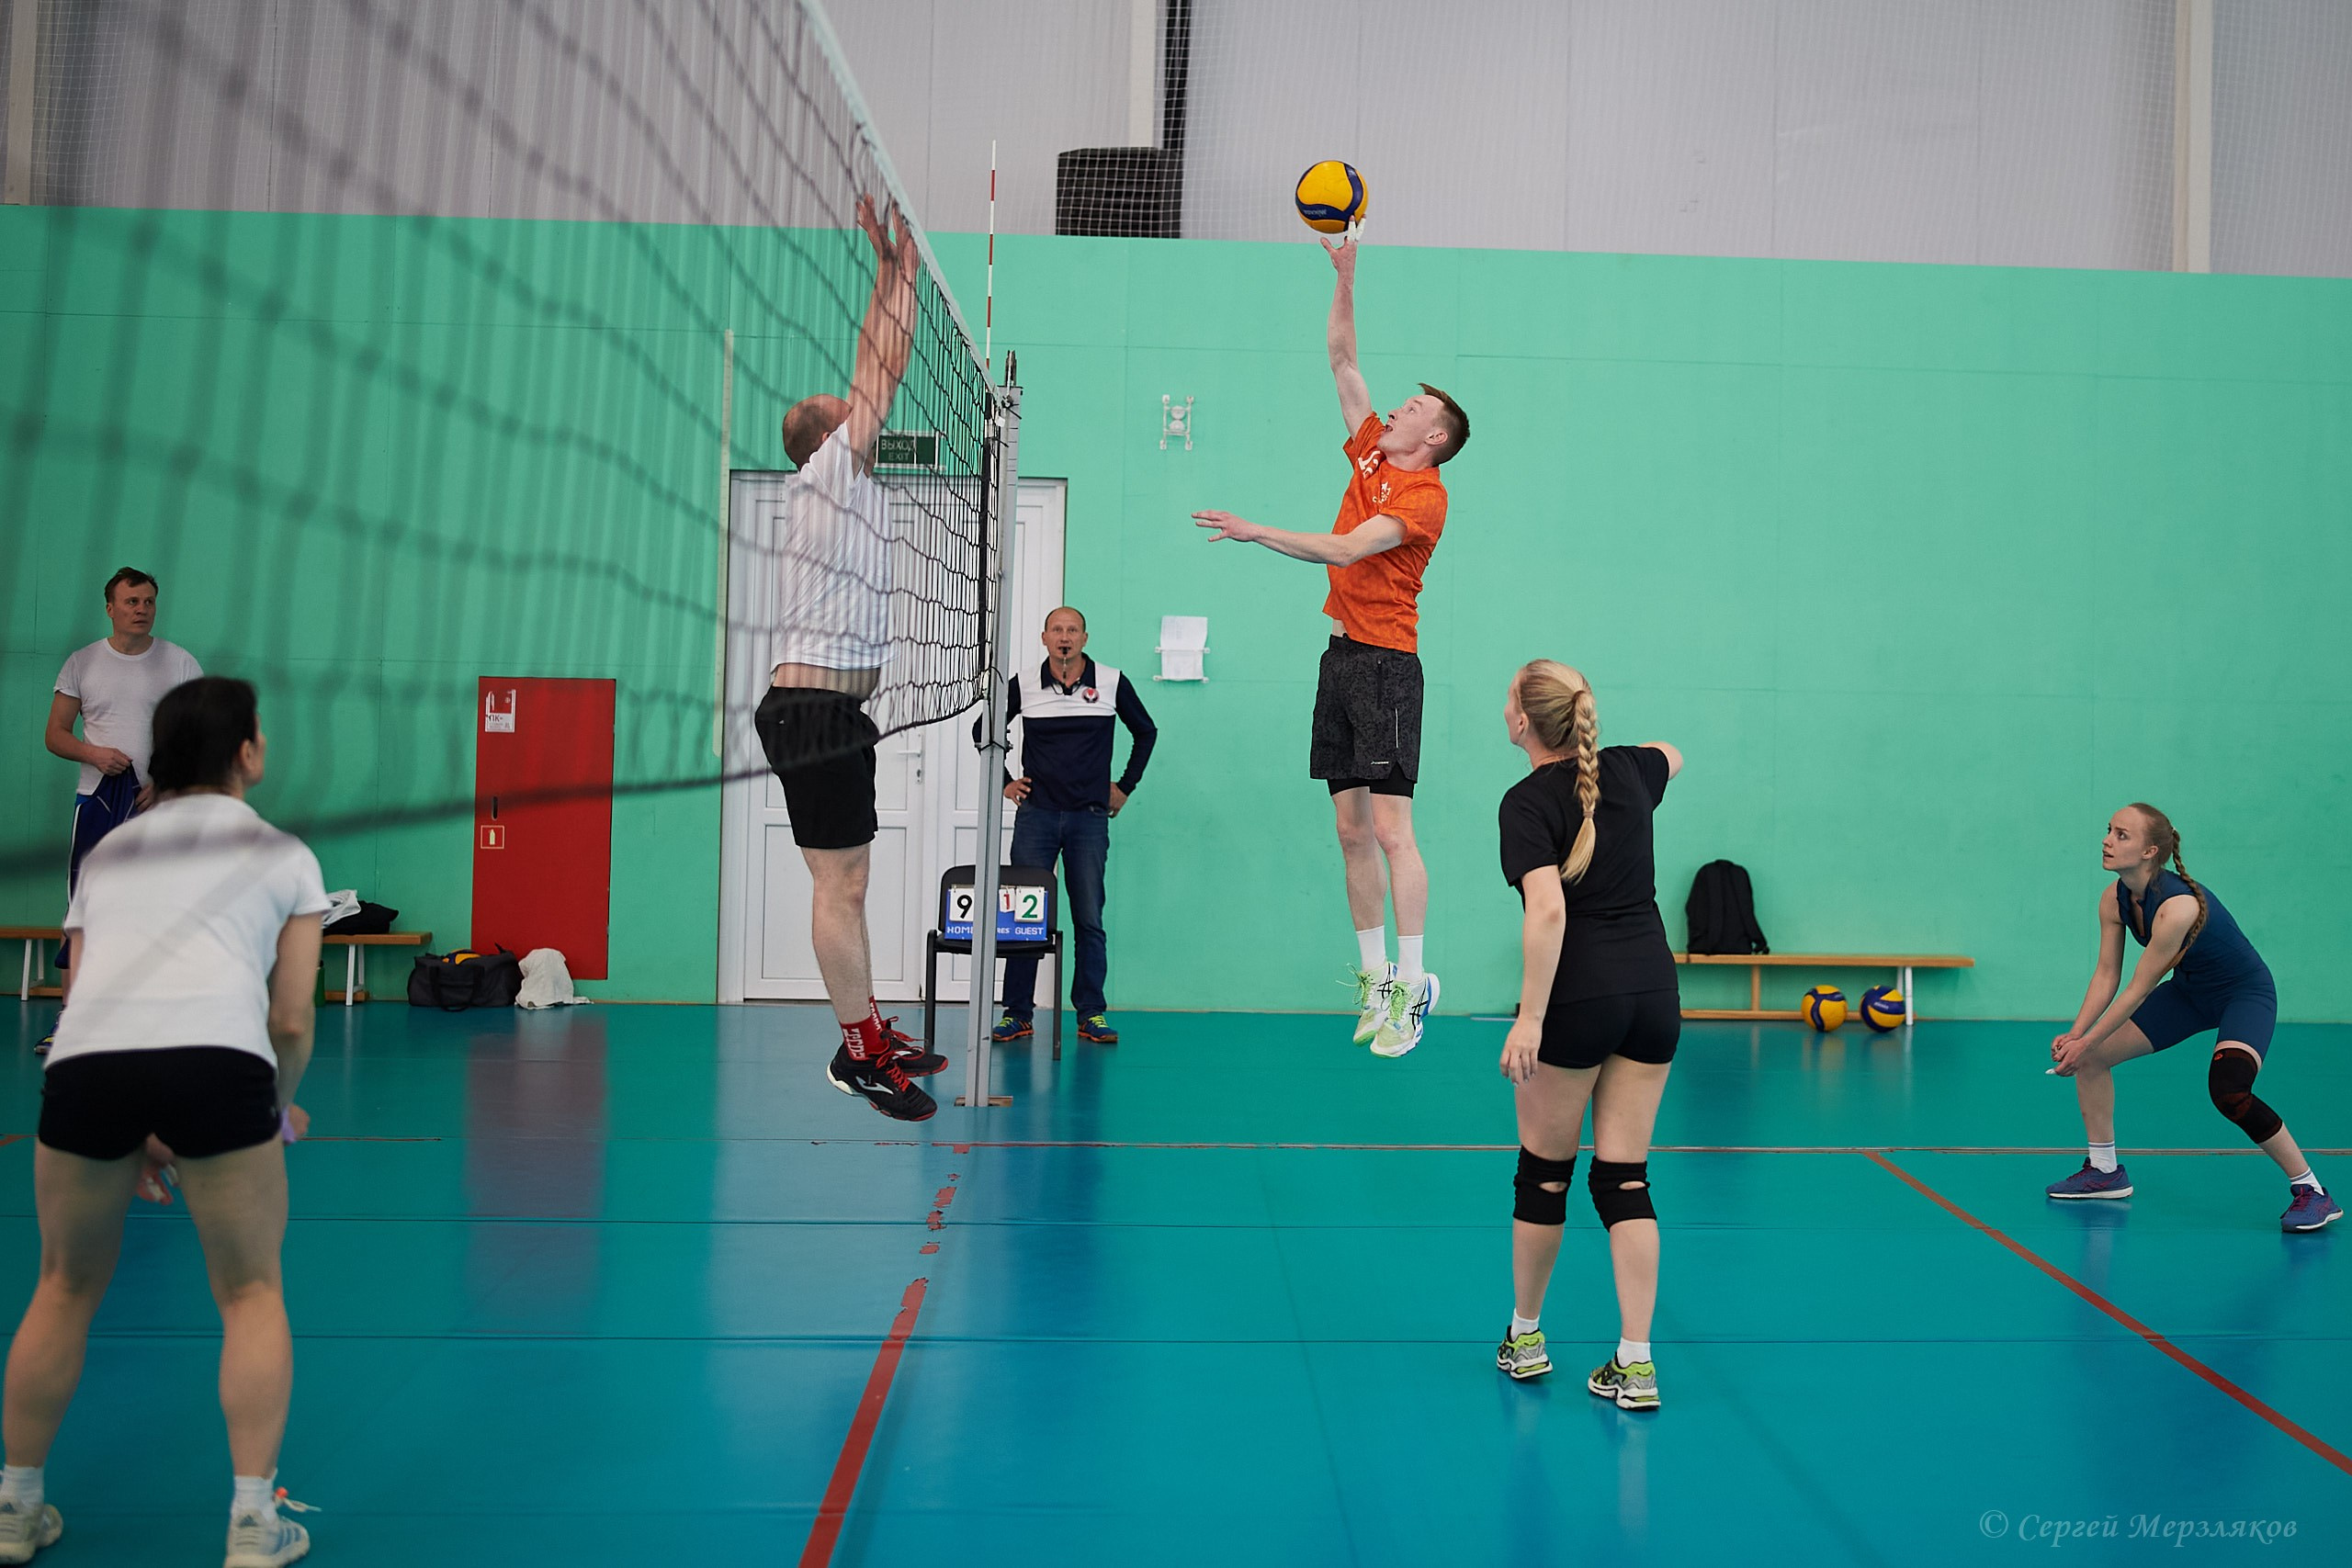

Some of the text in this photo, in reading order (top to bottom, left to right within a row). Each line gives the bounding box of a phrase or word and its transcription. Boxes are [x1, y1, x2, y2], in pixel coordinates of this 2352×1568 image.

[888, 452, 910, 460] EXIT
[956, 894, 1038, 919] 9 1 2
[1014, 927, 1044, 935] GUEST
